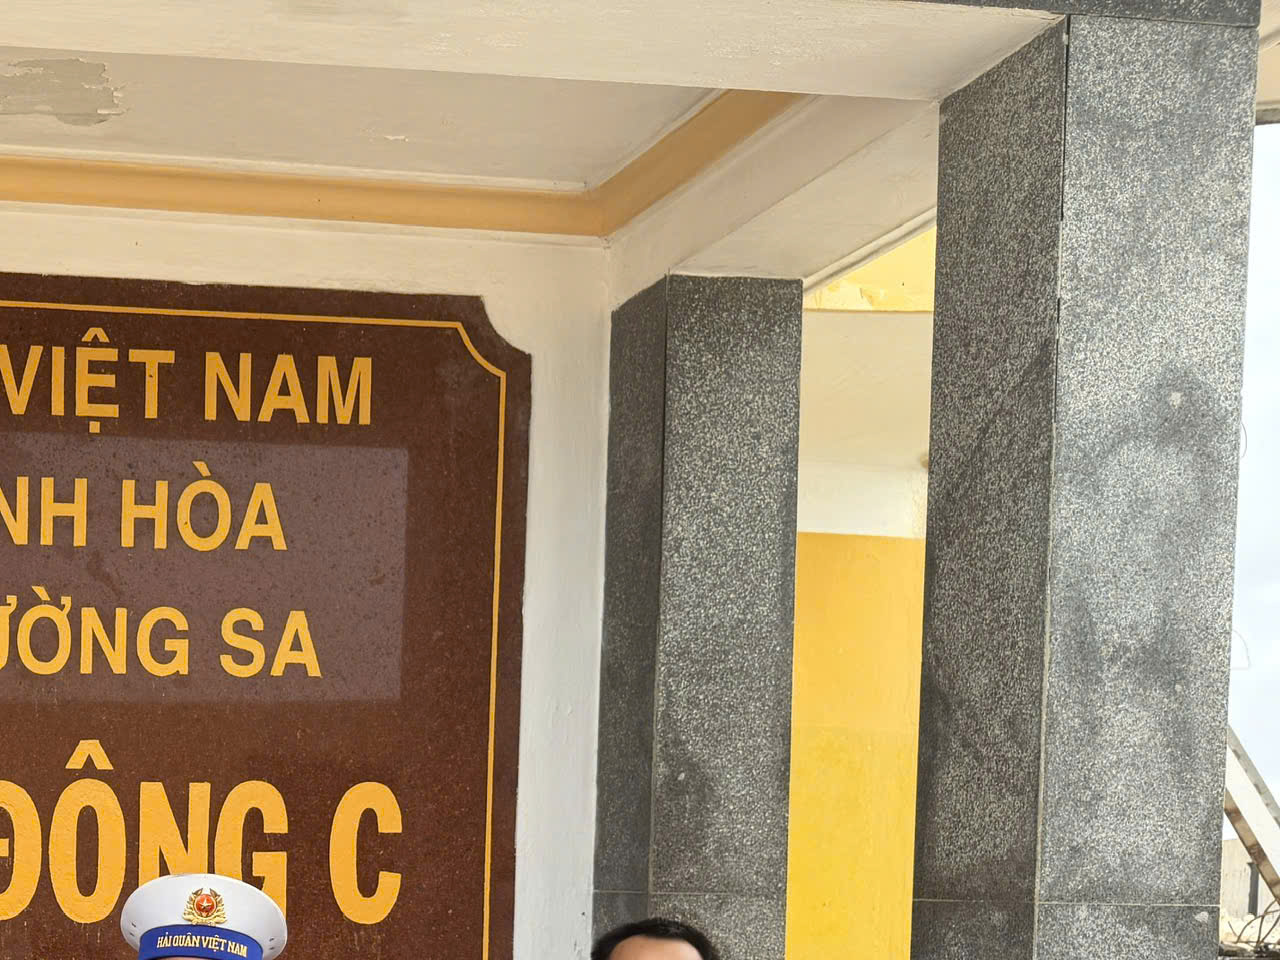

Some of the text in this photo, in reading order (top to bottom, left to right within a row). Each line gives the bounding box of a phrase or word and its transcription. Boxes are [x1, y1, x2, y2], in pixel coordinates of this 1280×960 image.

[203, 351, 373, 426] NAM
[120, 460, 288, 552] HÒA
[219, 606, 322, 678] SA
[328, 780, 403, 925] C
[156, 931, 248, 958] HẢI QUÂN VIỆT NAM
